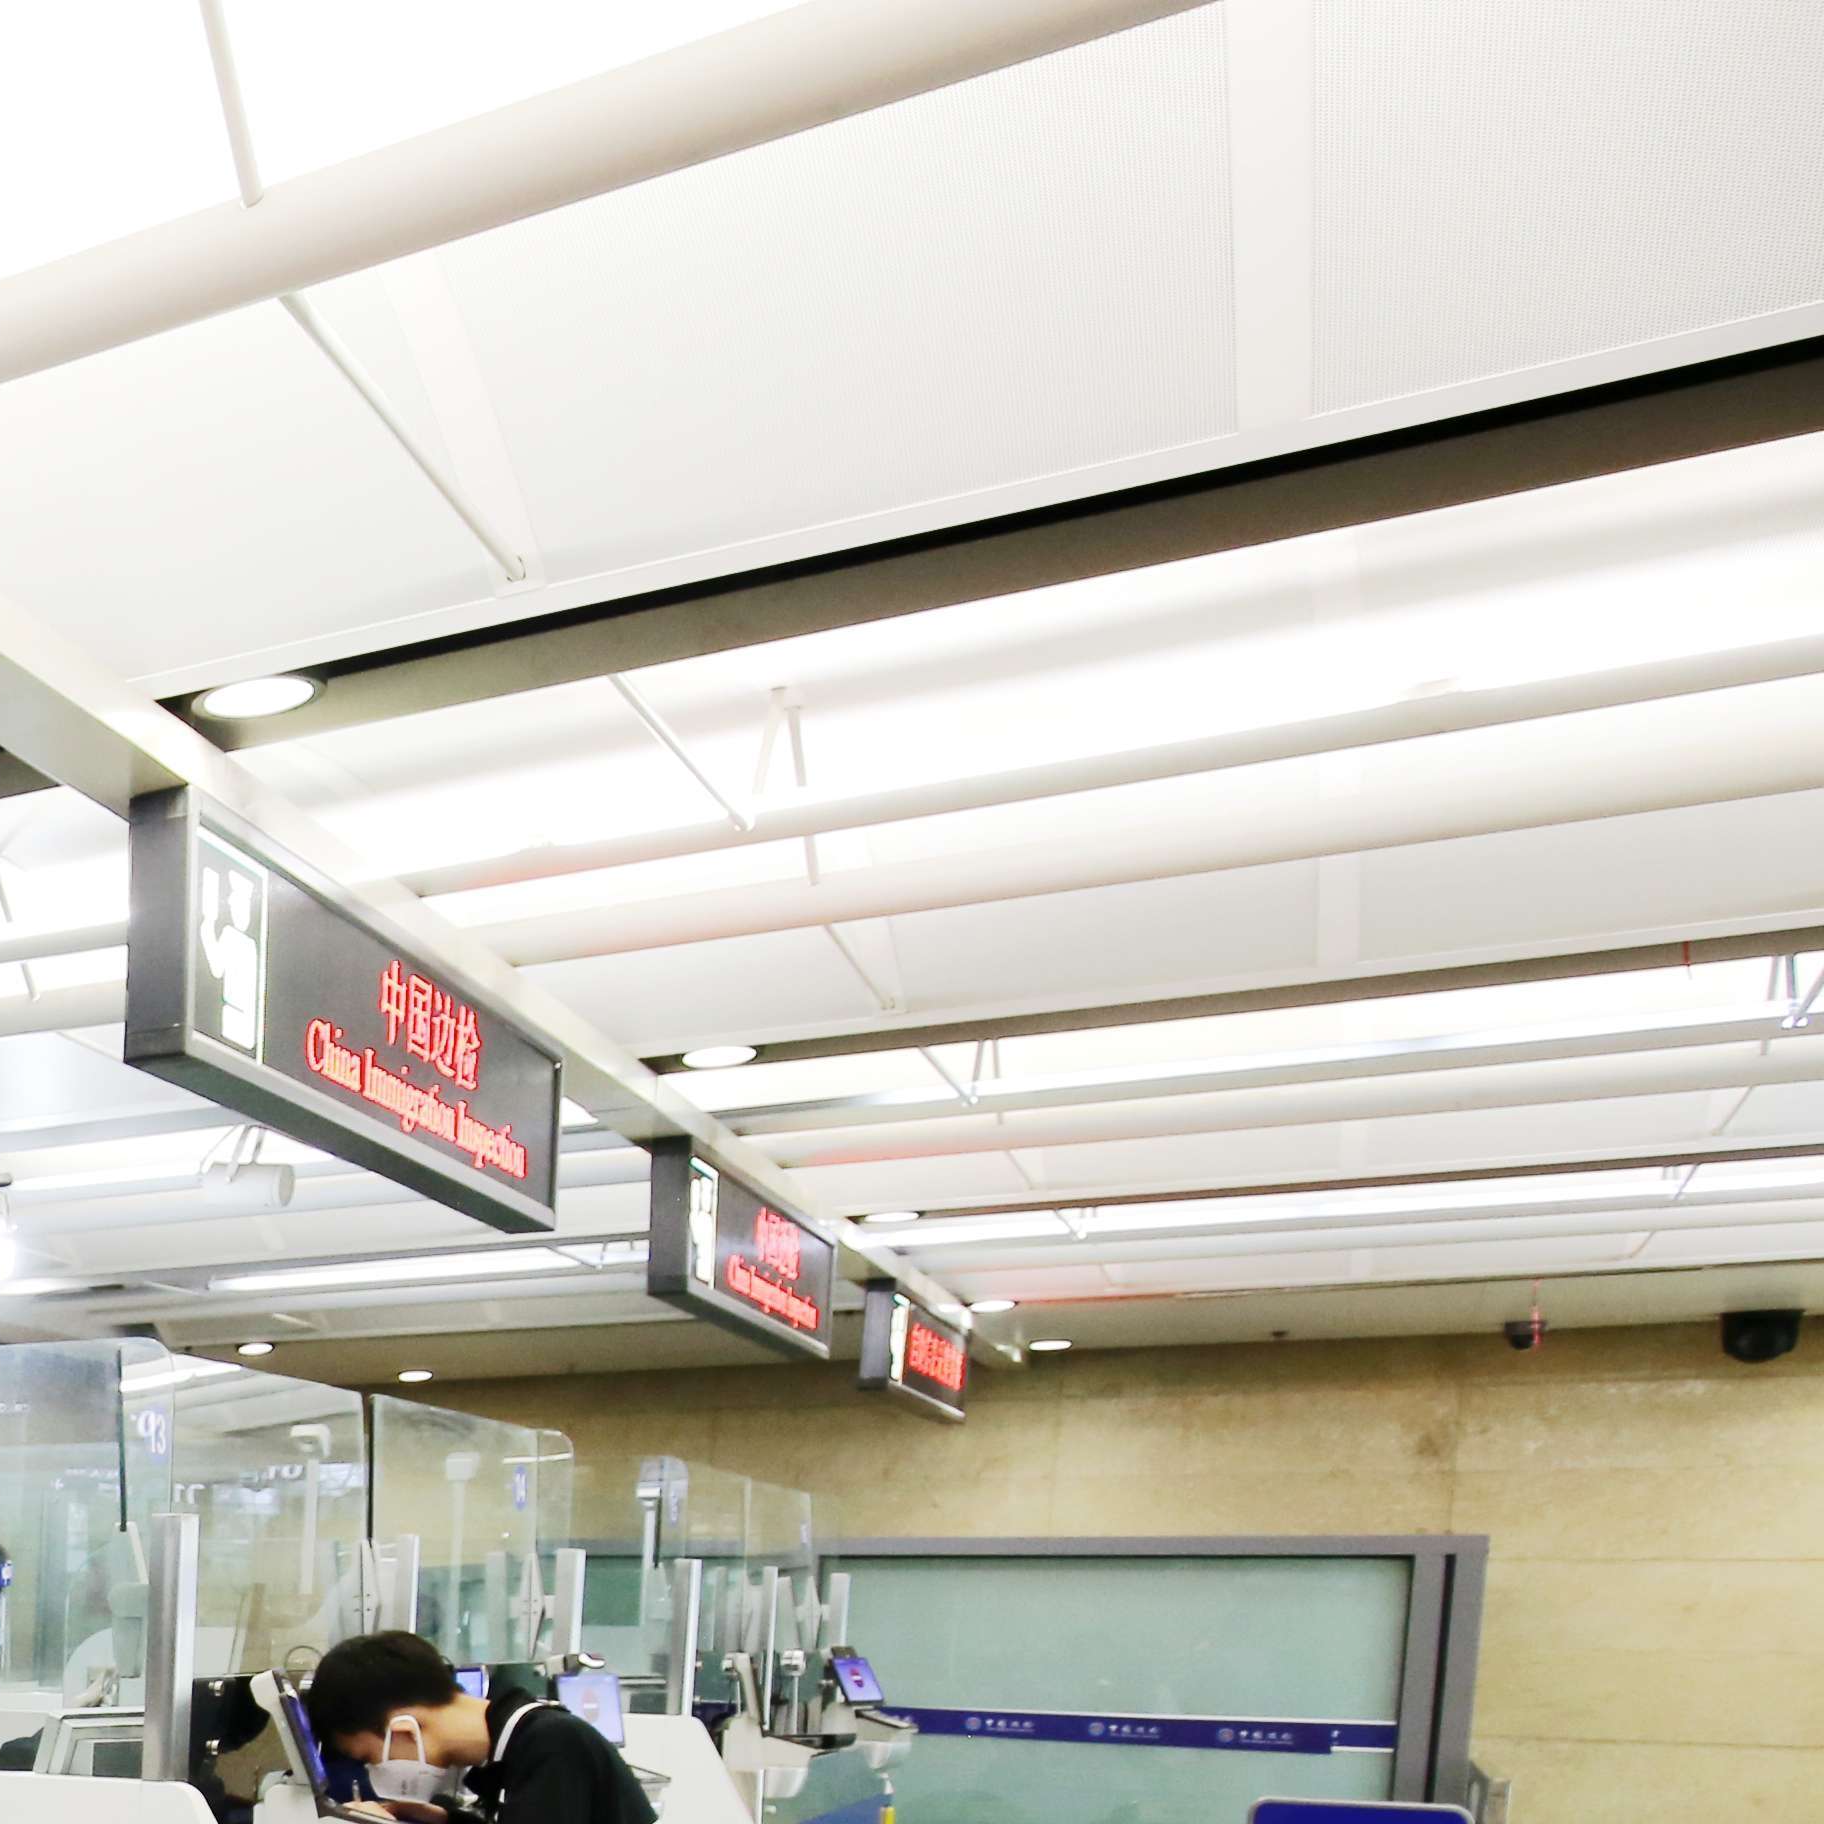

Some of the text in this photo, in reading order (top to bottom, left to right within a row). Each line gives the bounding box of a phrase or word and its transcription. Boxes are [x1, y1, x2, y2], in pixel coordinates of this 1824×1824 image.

[306, 1017, 527, 1179] China Immigration Inspection
[379, 959, 482, 1091] 中国边检
